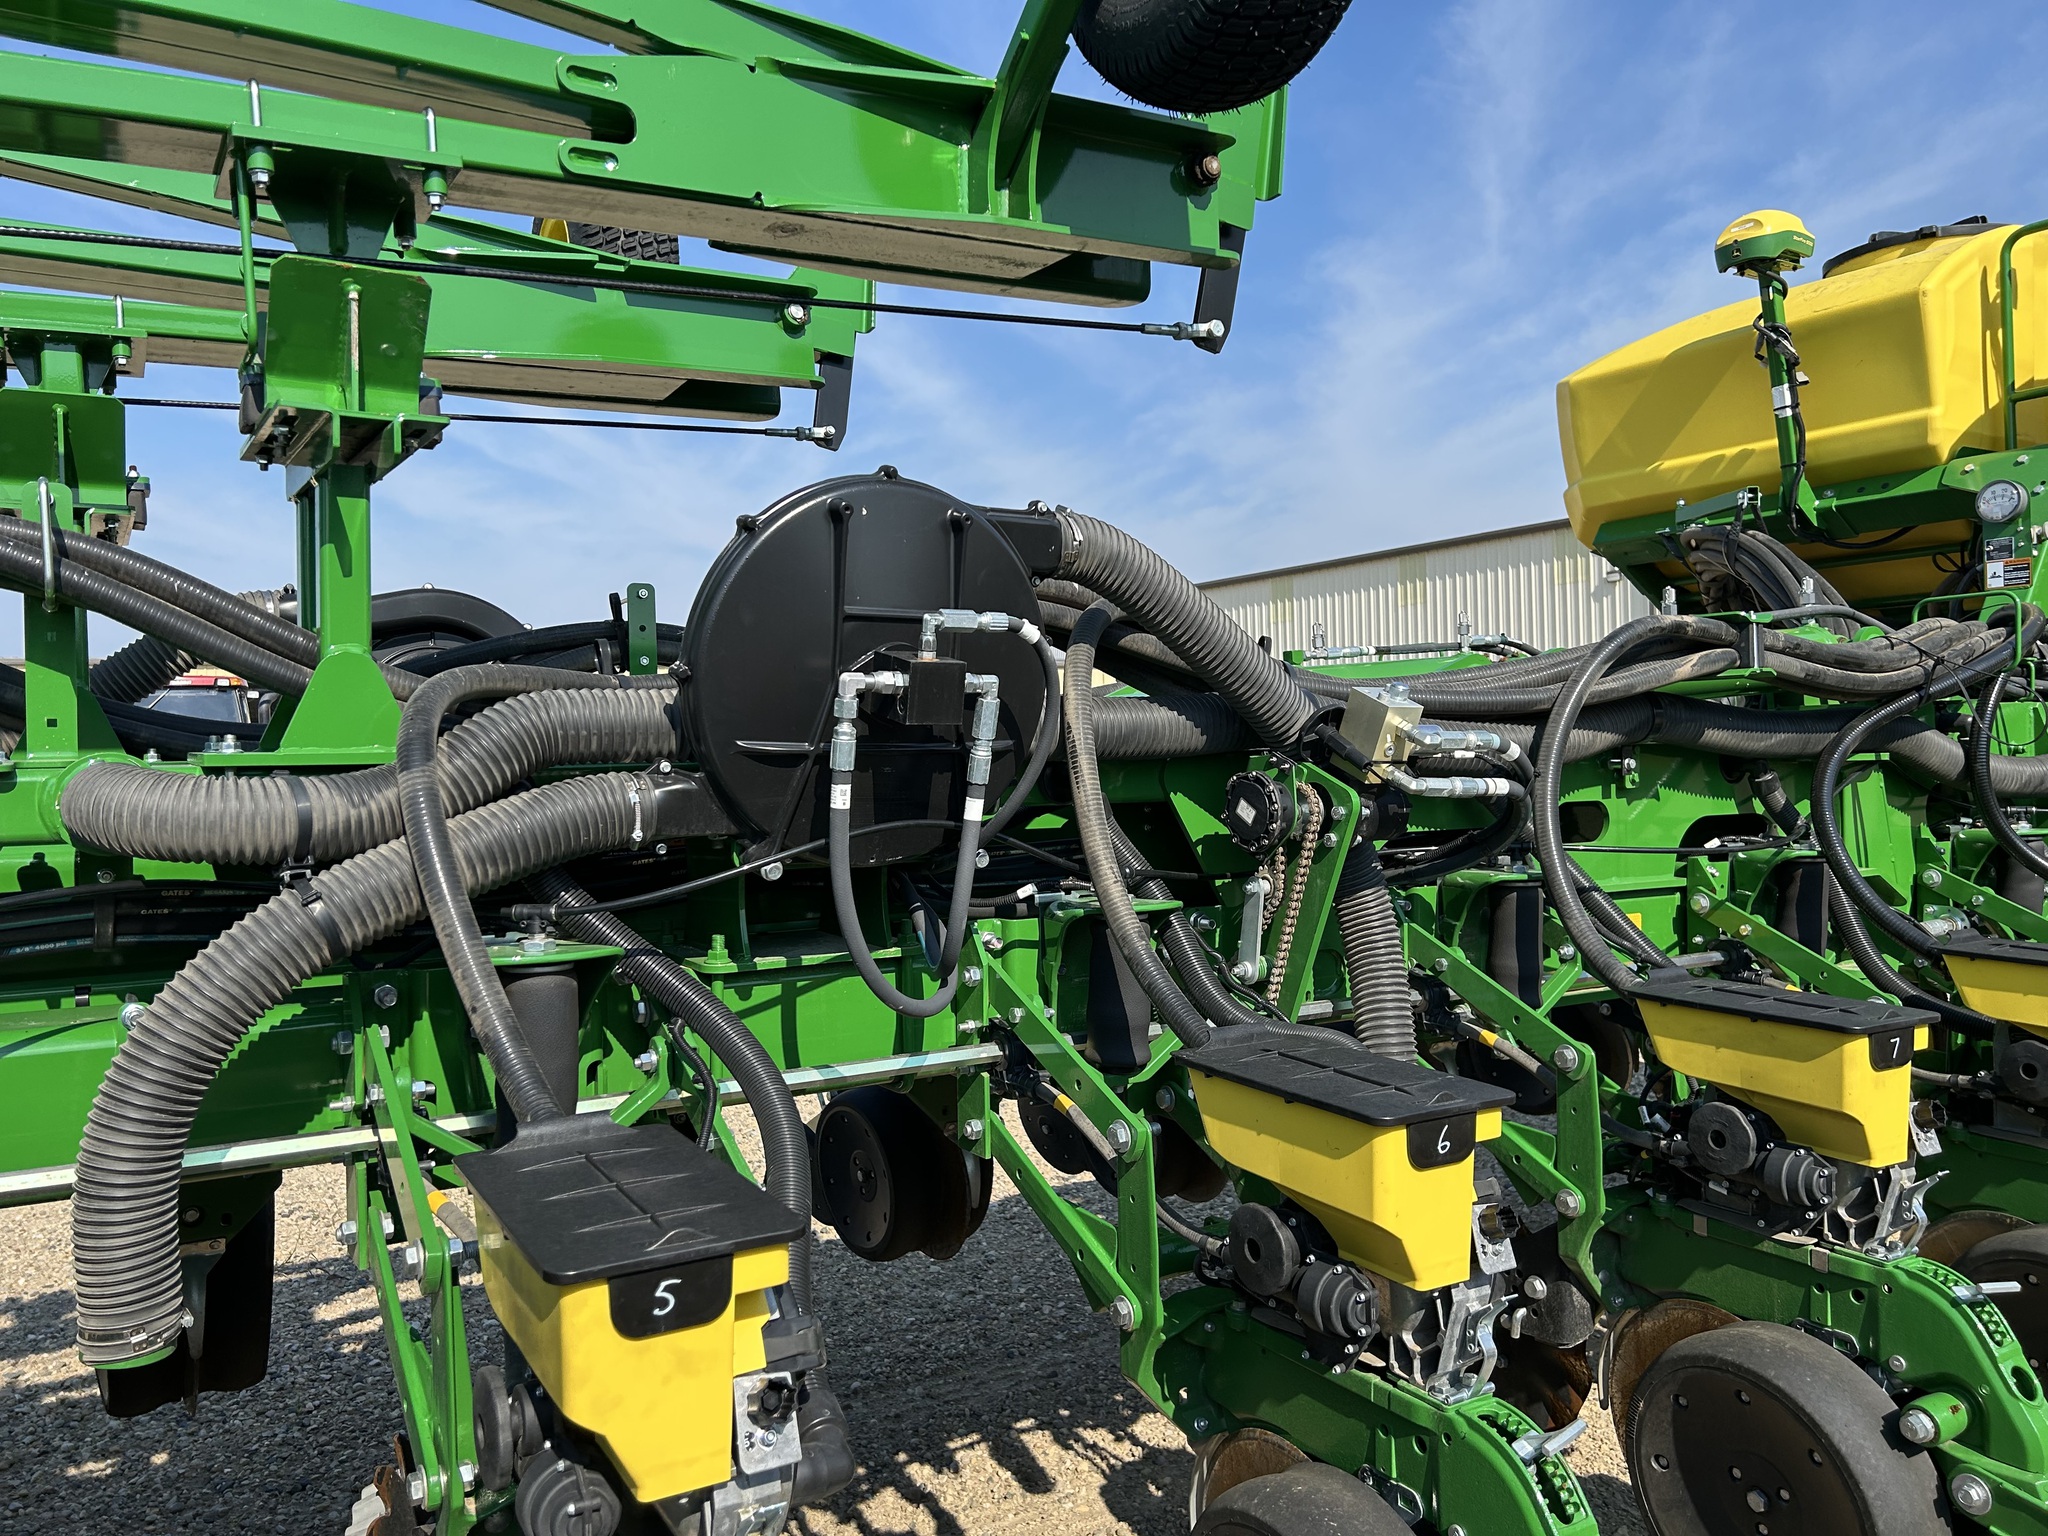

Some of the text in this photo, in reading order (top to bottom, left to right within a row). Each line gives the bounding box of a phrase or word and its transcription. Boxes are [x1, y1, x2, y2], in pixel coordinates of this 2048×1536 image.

[1890, 1037, 1900, 1059] 7
[1437, 1124, 1451, 1154] 6
[653, 1279, 682, 1315] 5
